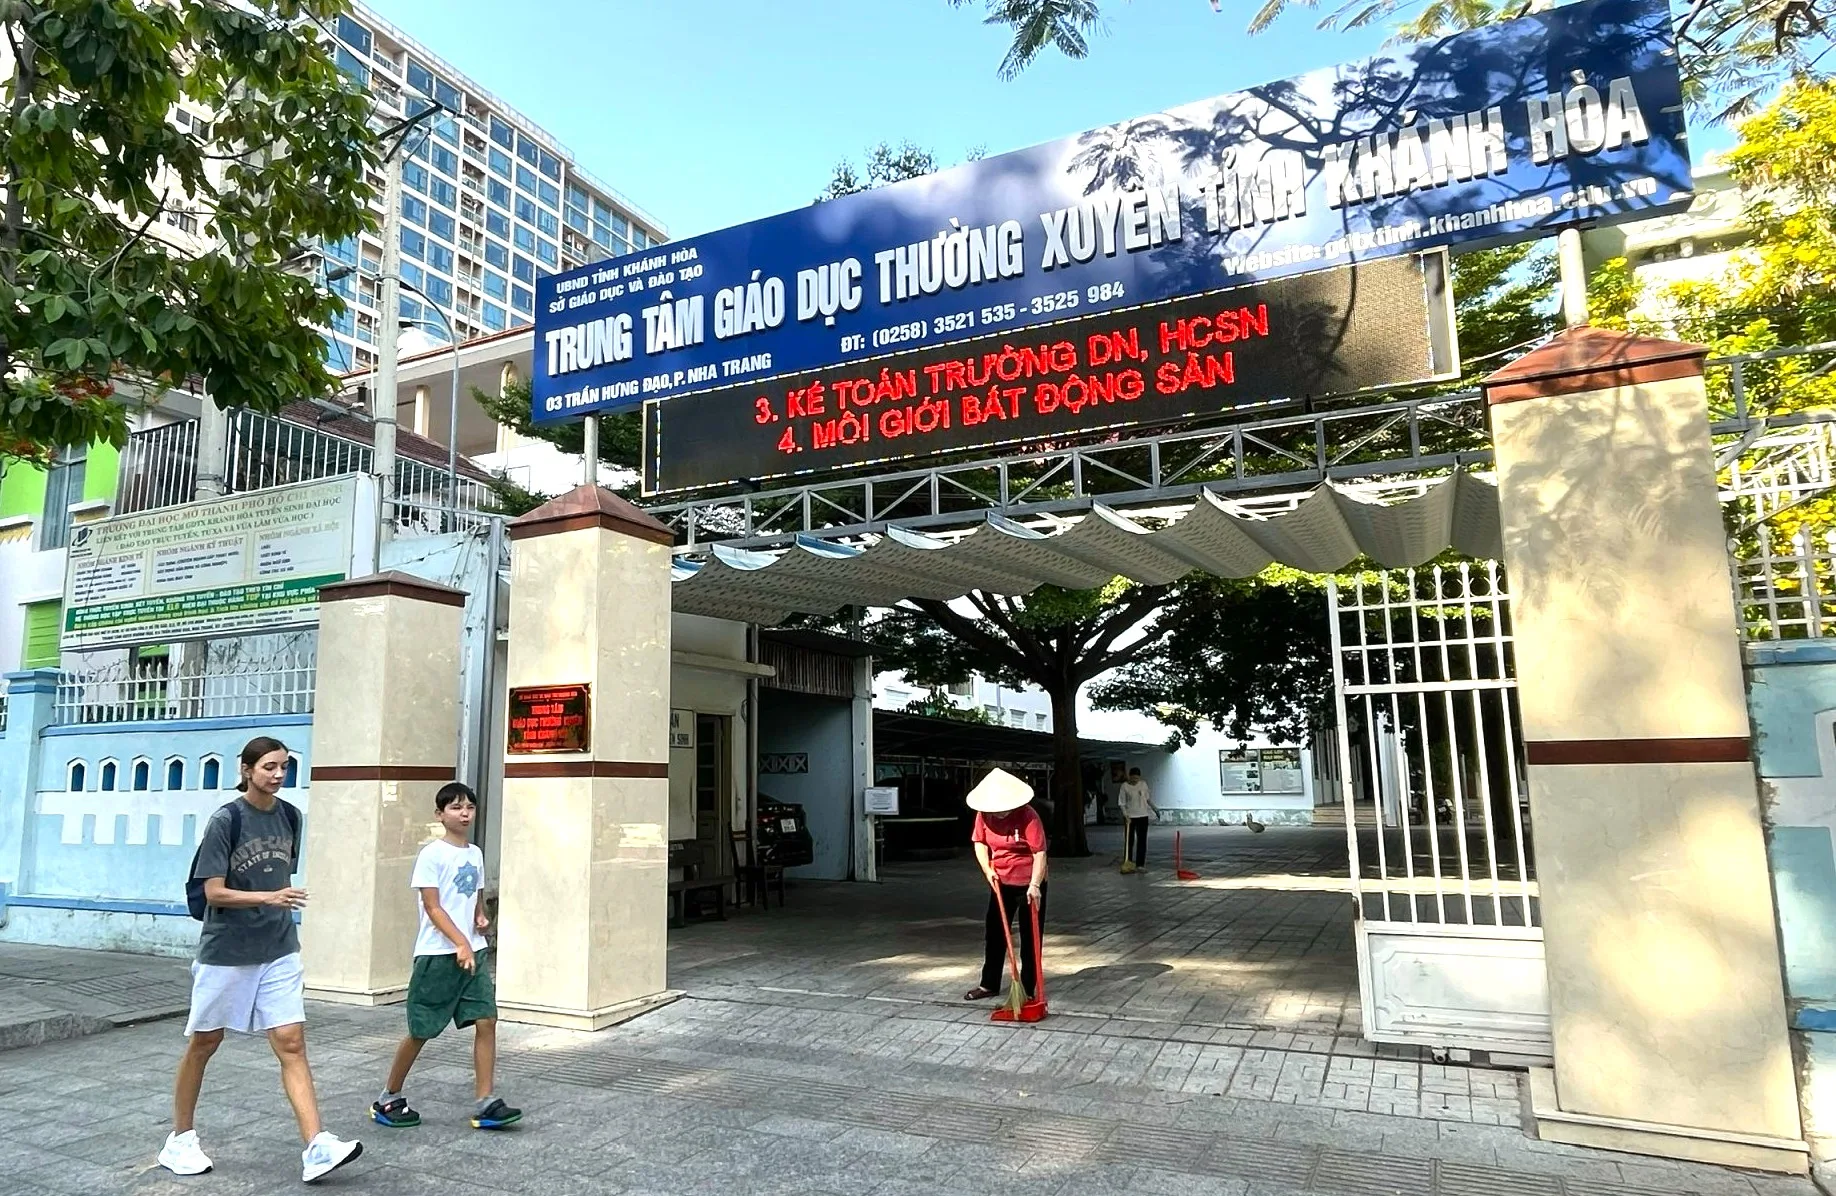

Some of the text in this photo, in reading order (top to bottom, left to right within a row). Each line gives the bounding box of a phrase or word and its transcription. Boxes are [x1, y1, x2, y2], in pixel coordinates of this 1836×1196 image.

[545, 69, 1649, 377] TRUNG TÂM GIÁO DỤC THƯỜNG XUYÊN TỈNH KHÁNH HÒA
[549, 264, 704, 314] SỞ GIÁO DỤC VÀ ĐÀO TẠO
[556, 247, 699, 294] UBND TỈNH KHÁNH HÒA
[840, 333, 866, 353] ĐT:
[872, 319, 928, 348] (0258)
[933, 310, 975, 335] 3521
[981, 302, 1016, 326] 535
[1031, 289, 1080, 316] 3525
[1086, 281, 1125, 304] 984
[545, 395, 563, 412] 03
[601, 379, 639, 401] HƯNG
[687, 361, 718, 384] NHA
[721, 352, 772, 377] TRANG
[755, 396, 779, 424] 3.
[831, 367, 918, 410] TOÁN
[923, 341, 1078, 394] TRƯỜNG
[1088, 327, 1149, 367] DN,
[1159, 303, 1270, 354] HCSN
[778, 351, 1236, 454] 4. MÔI GIỚI BẤT ĐỘNG SẢN
[143, 526, 167, 538] TRUNG
[283, 502, 304, 514] SINH
[322, 496, 341, 508] HỌC
[159, 513, 180, 525] HỌC
[237, 853, 261, 874] STATE
